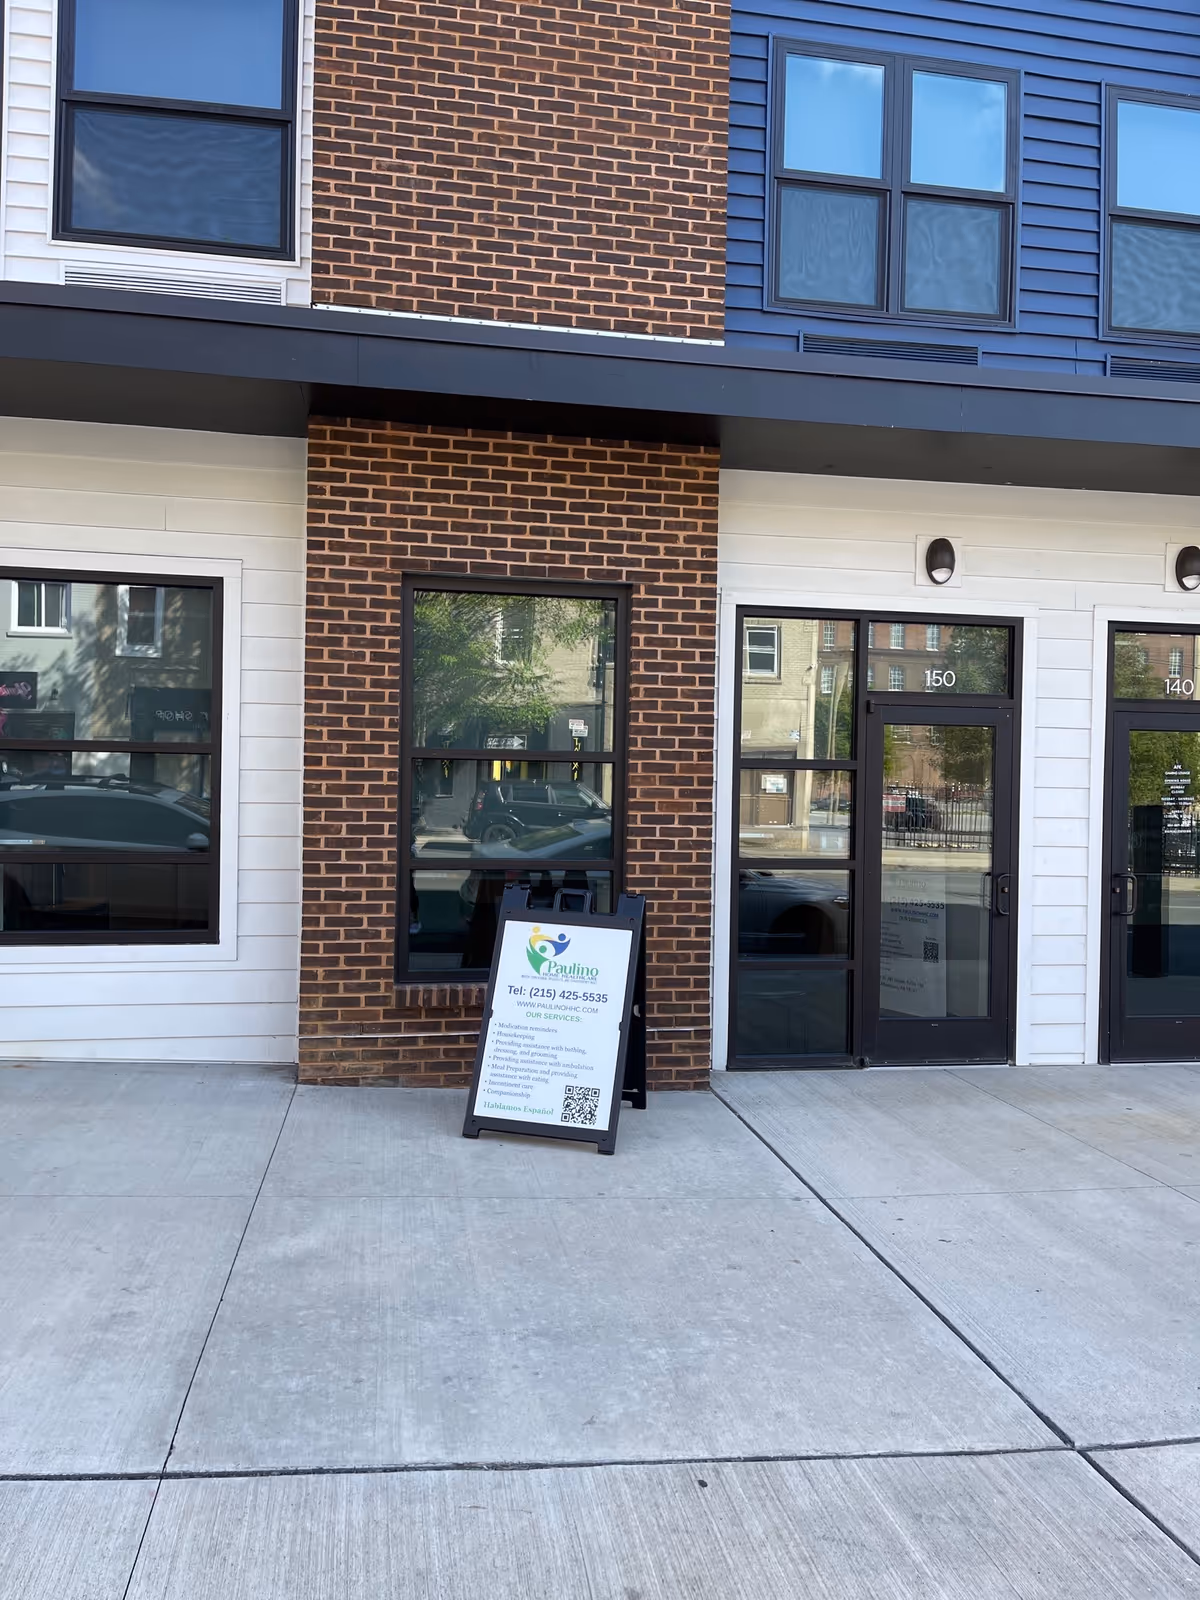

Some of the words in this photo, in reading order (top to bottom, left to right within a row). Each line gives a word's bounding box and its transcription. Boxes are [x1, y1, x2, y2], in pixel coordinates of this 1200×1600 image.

[925, 670, 956, 687] 150
[1164, 678, 1195, 695] 140
[547, 960, 599, 977] Paulino
[507, 985, 527, 996] Tel:
[529, 986, 557, 1000] (215)
[559, 990, 609, 1004] 425-5535
[516, 1000, 599, 1014] WWW.PAULINOHHC.COM
[526, 1011, 542, 1019] OUR
[543, 1012, 583, 1022] SERVICES:
[496, 1030, 536, 1041] Housekeeping
[529, 1025, 558, 1033] reminders
[495, 1039, 522, 1048] Providing
[551, 1044, 564, 1052] with
[492, 1055, 519, 1064] Providing
[491, 1063, 505, 1071] Meal
[506, 1065, 539, 1075] Preparation
[550, 1070, 578, 1079] providing
[486, 1087, 531, 1099] Companionship
[483, 1100, 522, 1112] Hablamos
[523, 1105, 554, 1116] Español
